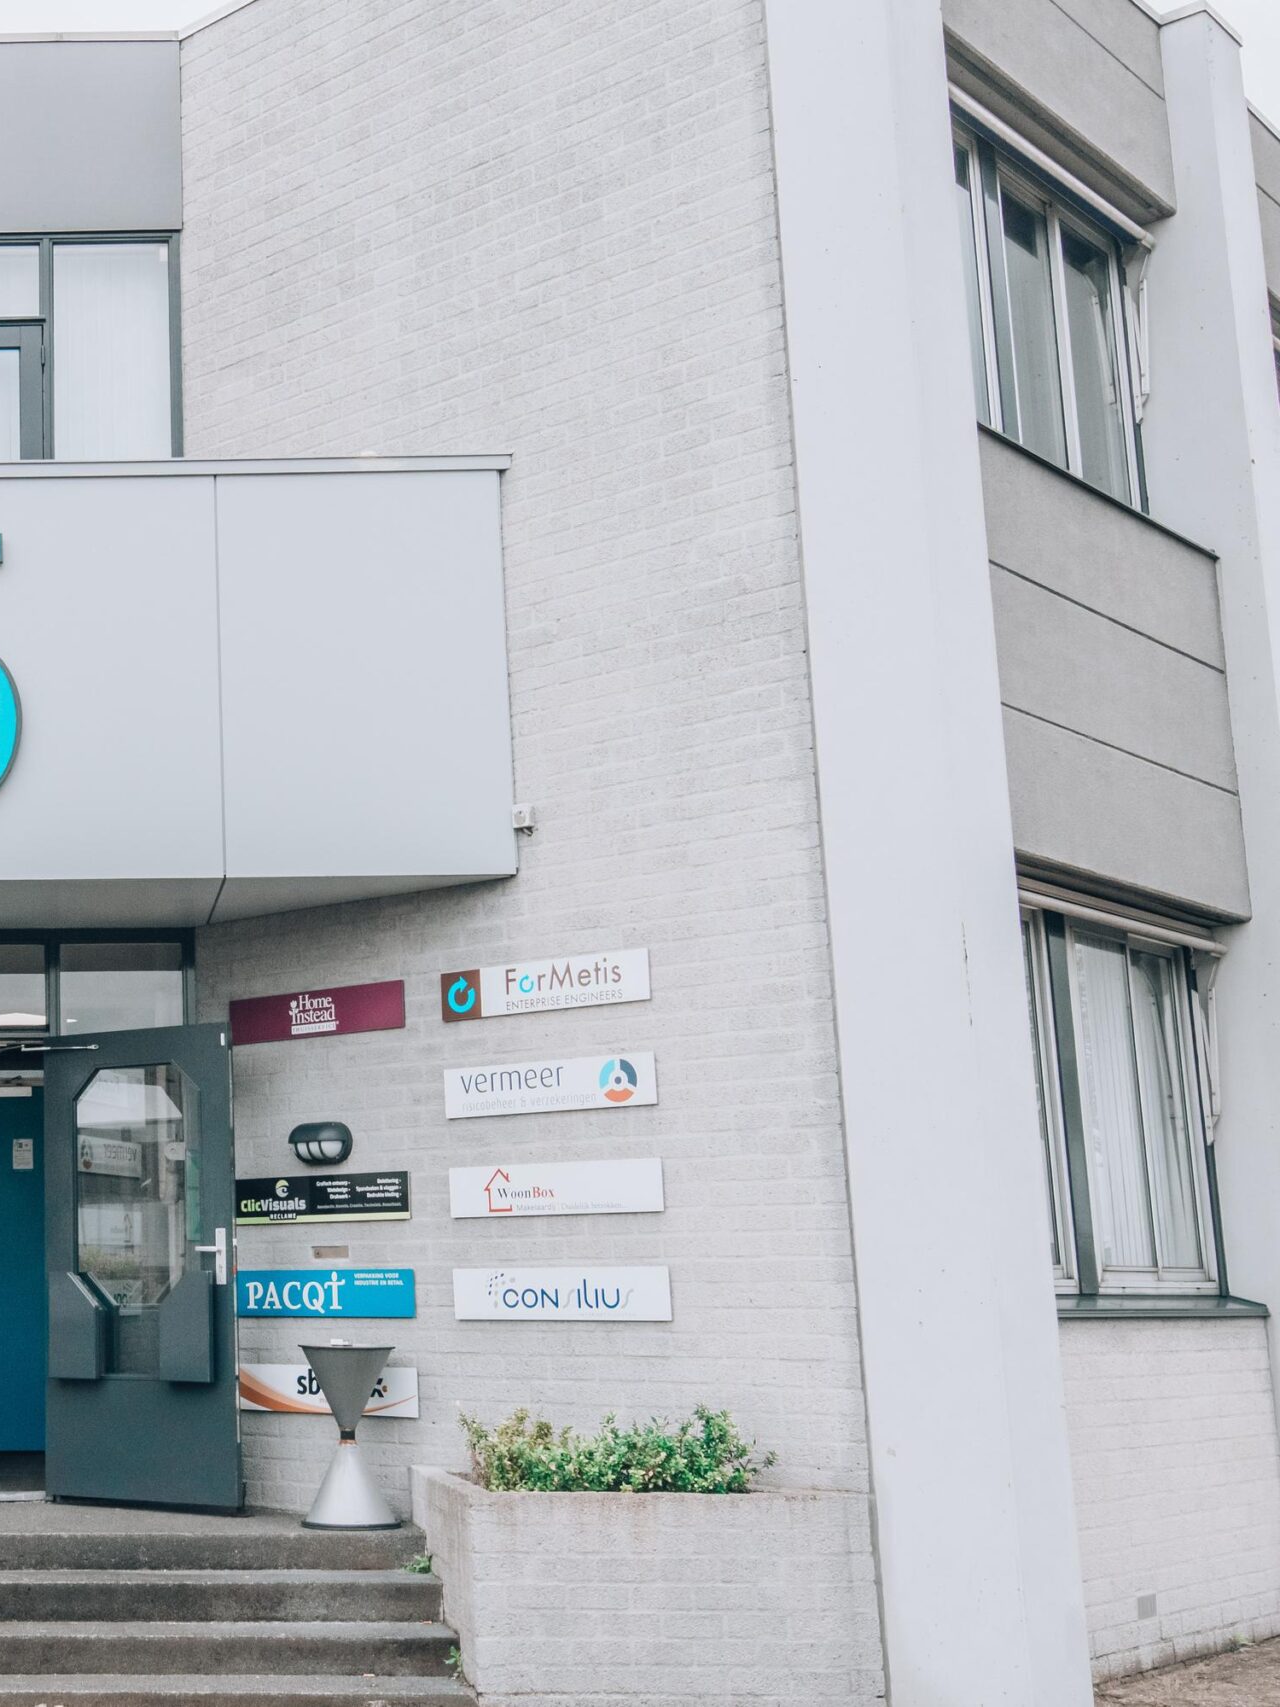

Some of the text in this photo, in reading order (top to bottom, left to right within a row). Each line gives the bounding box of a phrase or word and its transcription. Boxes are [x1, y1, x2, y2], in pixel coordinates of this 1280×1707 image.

[505, 957, 622, 995] ForMetis
[298, 994, 332, 1010] Home
[506, 989, 623, 1011] ENTERPRISE ENGINEERS
[292, 1003, 336, 1024] Instead
[460, 1066, 564, 1094] vermeer
[462, 1098, 516, 1113] risicobeheer
[530, 1092, 597, 1107] verzekeringen
[497, 1186, 555, 1199] WoonBox
[241, 1197, 306, 1212] ClicVisuals
